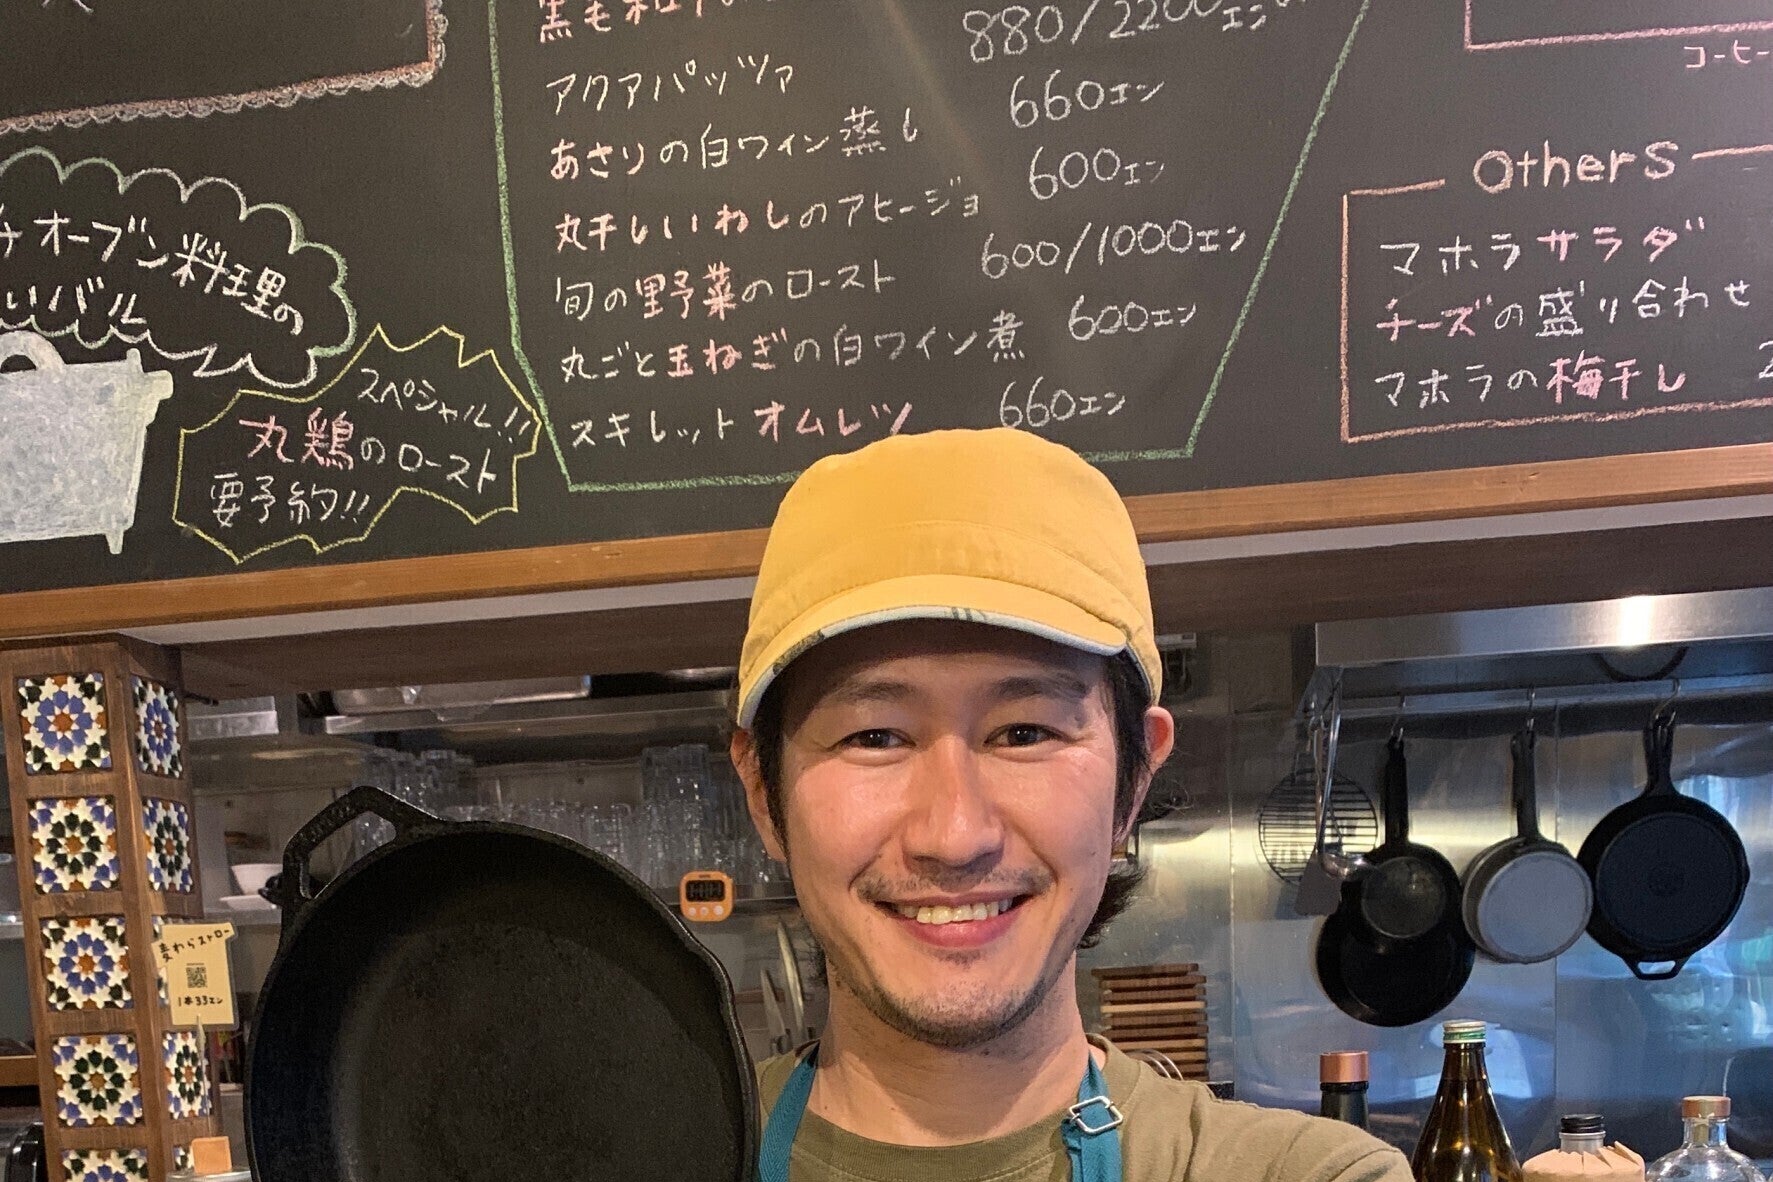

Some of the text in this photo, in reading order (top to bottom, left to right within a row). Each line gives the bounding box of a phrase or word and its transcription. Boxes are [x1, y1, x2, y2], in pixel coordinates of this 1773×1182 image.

[546, 54, 1164, 128] アクアパッツァ 660エン
[551, 105, 1164, 200] あさりの白ワイン蒸し 600エン
[555, 177, 1247, 279] 丸干しいわしのアヒージョ 600/1000エン
[1380, 217, 1705, 276] マホラサラダ
[554, 260, 895, 320] 旬の野菜のロースト
[1376, 276, 1750, 342] チーズの盛り合わせ
[561, 295, 1196, 383] 丸ごと玉ねぎの白ワイン煮 600エン
[1000, 377, 1126, 428] 660エン
[1375, 350, 1686, 409] マホラの梅干し
[240, 407, 496, 493] 丸鶏のロースト
